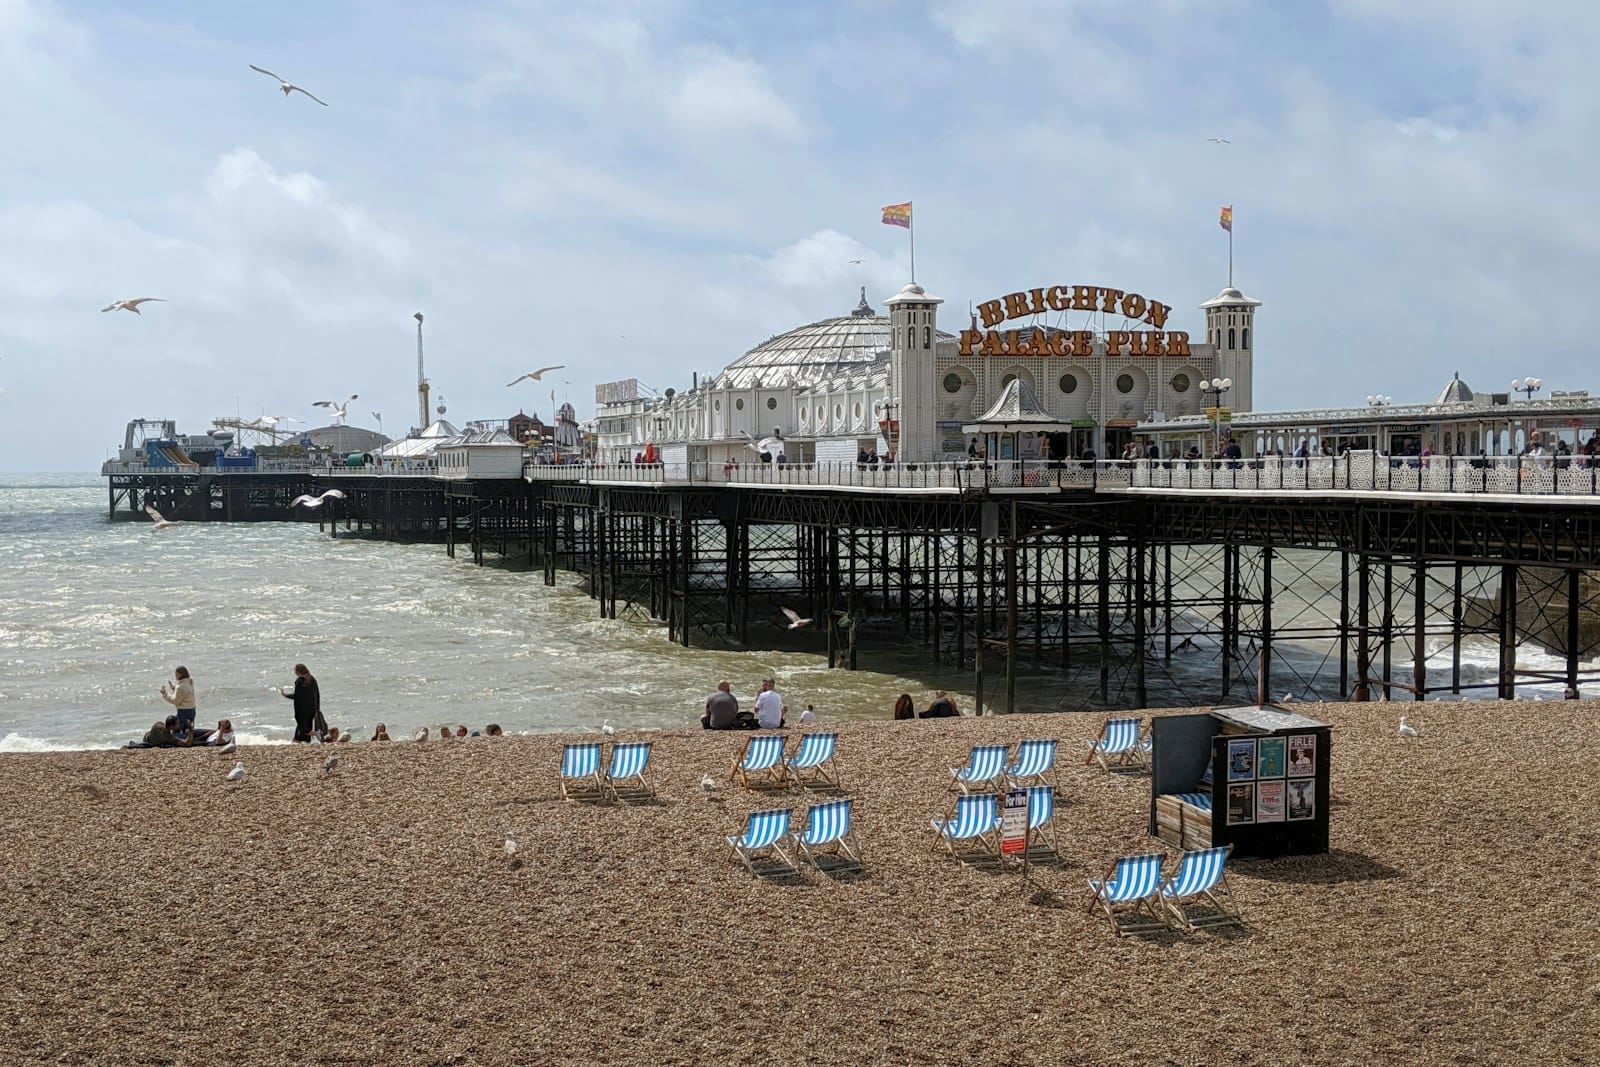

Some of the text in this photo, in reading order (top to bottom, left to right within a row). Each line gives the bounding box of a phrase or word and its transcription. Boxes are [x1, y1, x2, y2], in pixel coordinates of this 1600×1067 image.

[975, 285, 1173, 329] BRIGHTON
[959, 330, 1191, 356] PALACE PIER
[1290, 737, 1314, 747] FIRLE
[1005, 792, 1027, 807] For Hire
